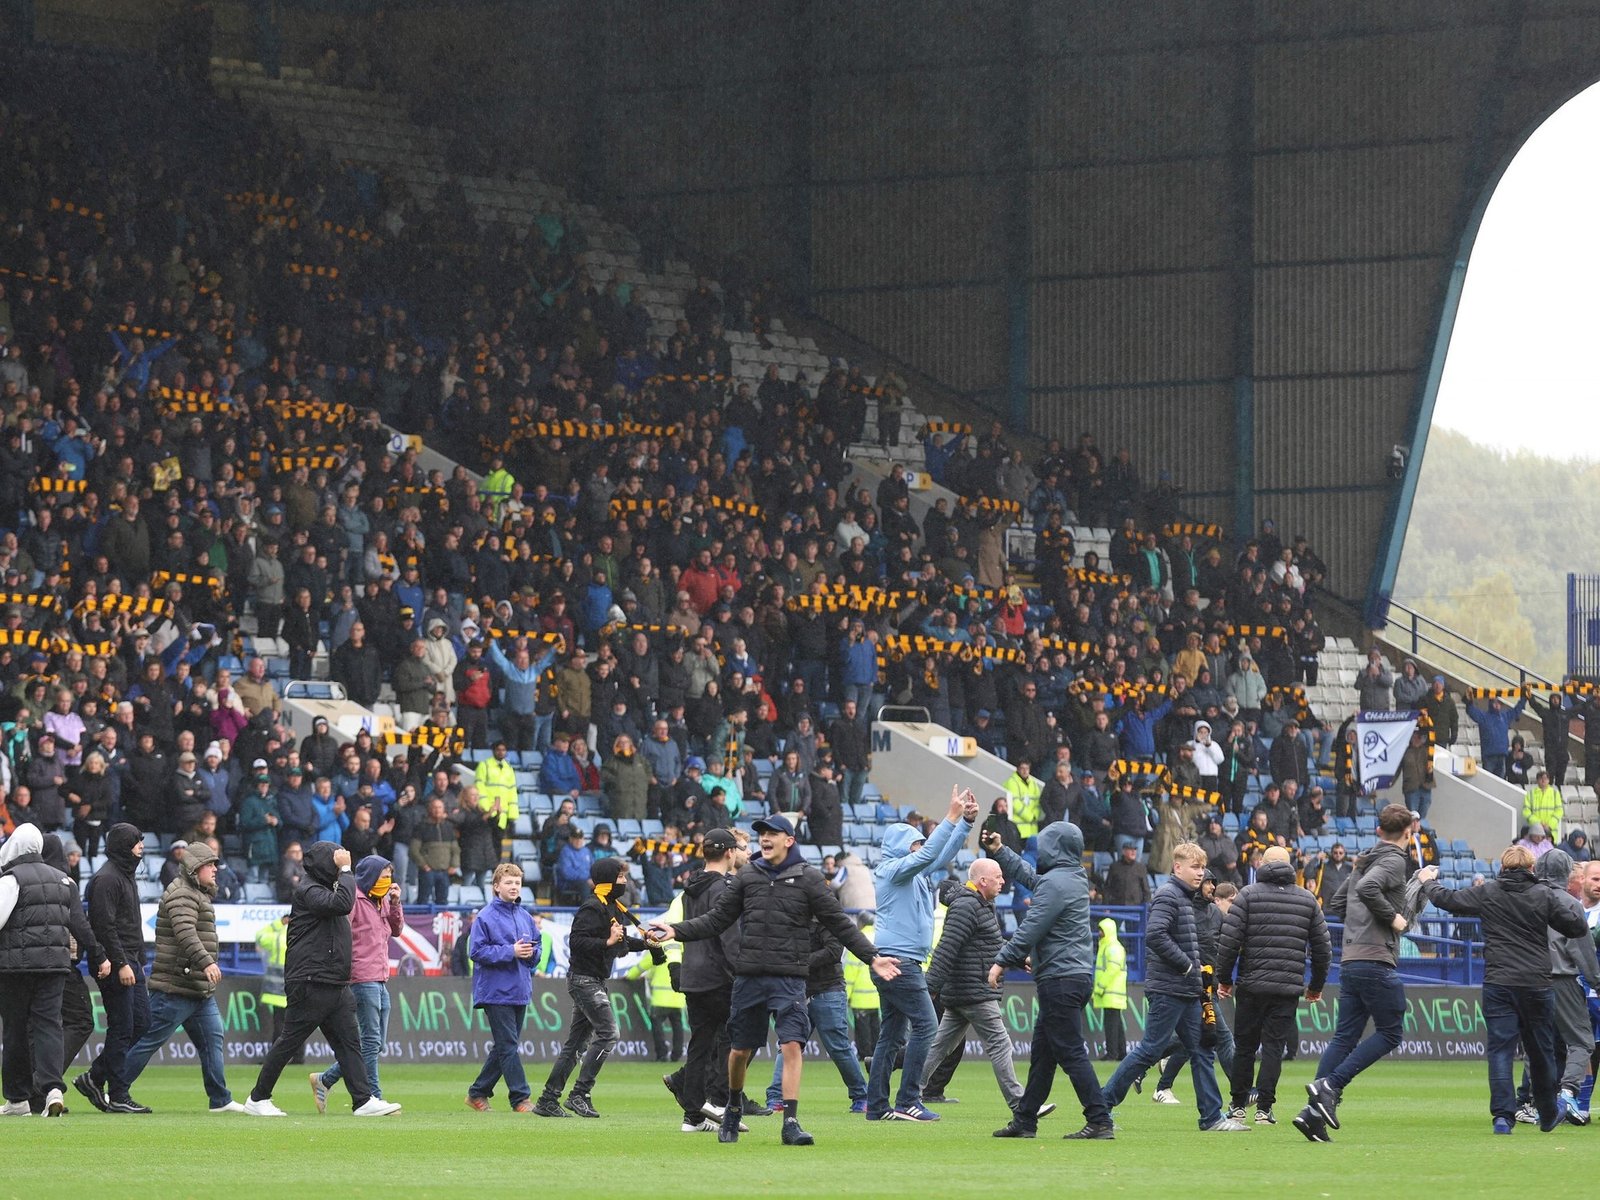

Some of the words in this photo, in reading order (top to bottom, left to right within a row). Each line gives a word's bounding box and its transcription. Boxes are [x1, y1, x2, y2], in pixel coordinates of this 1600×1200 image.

[906, 472, 915, 483] P
[282, 710, 293, 727] N
[361, 716, 372, 733] N
[872, 730, 891, 751] M
[946, 737, 958, 755] M
[1451, 757, 1460, 776] L
[241, 908, 289, 921] ACCESS
[398, 991, 450, 1033] MR
[169, 1042, 197, 1058] SLO
[227, 1042, 272, 1058] SPORT
[418, 1041, 468, 1057] SPORTS
[1397, 1041, 1433, 1056] SPORTS
[1446, 1042, 1485, 1056] CASINO
